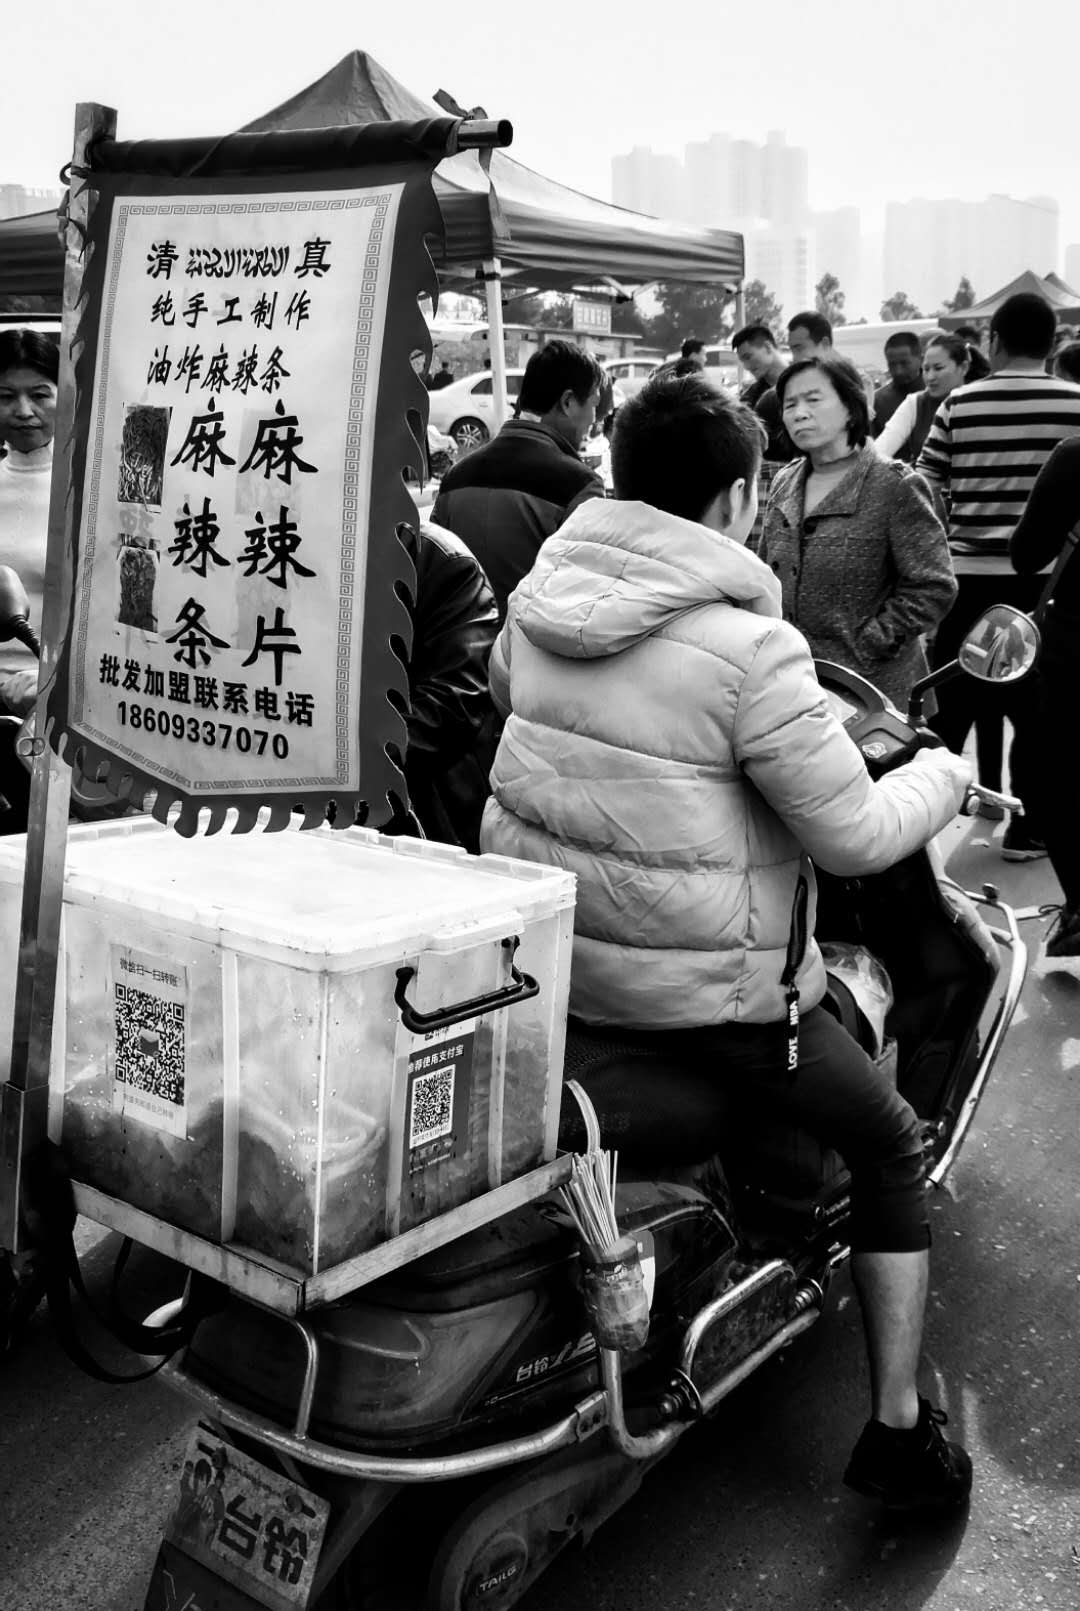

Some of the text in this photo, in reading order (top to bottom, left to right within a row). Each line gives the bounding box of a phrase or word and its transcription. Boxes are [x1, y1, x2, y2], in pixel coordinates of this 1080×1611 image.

[146, 236, 332, 280] 清 真
[151, 289, 311, 330] 纯手工制作
[147, 343, 291, 395] 油炸麻辣条
[165, 396, 237, 670] 麻辣条
[237, 398, 319, 686] 麻辣片
[99, 653, 315, 728] 批发加盟联系电话
[117, 701, 290, 759] 18609337070
[787, 1036, 798, 1071] LOVE
[219, 1494, 308, 1585] 台铃
[479, 1564, 517, 1592] TAILG
